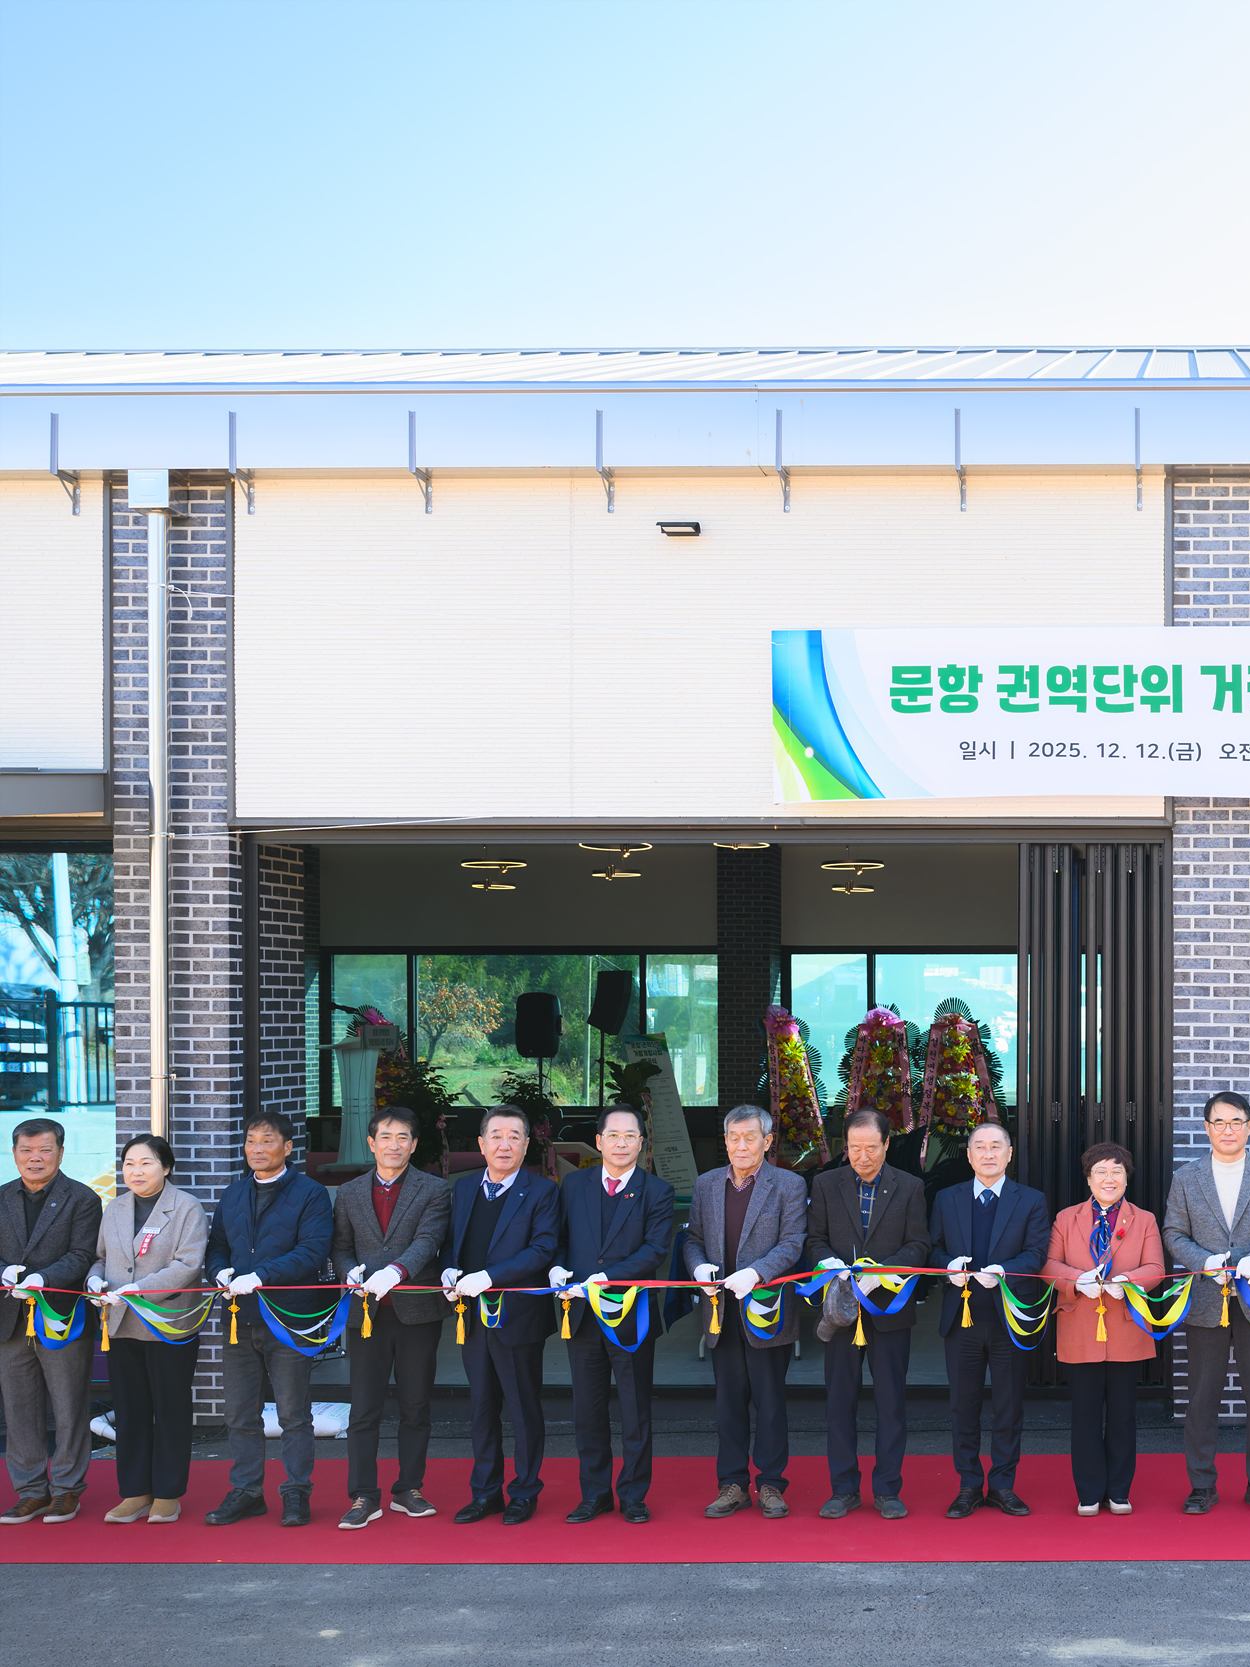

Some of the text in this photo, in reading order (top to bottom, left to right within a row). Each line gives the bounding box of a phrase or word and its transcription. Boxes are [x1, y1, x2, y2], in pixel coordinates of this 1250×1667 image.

[889, 663, 984, 714] 문항
[995, 663, 1184, 714] 권역단위
[959, 740, 996, 761] 일시
[1028, 742, 1087, 759] 2025.
[1096, 742, 1127, 759] 12.
[1135, 742, 1202, 762] 12.(금)
